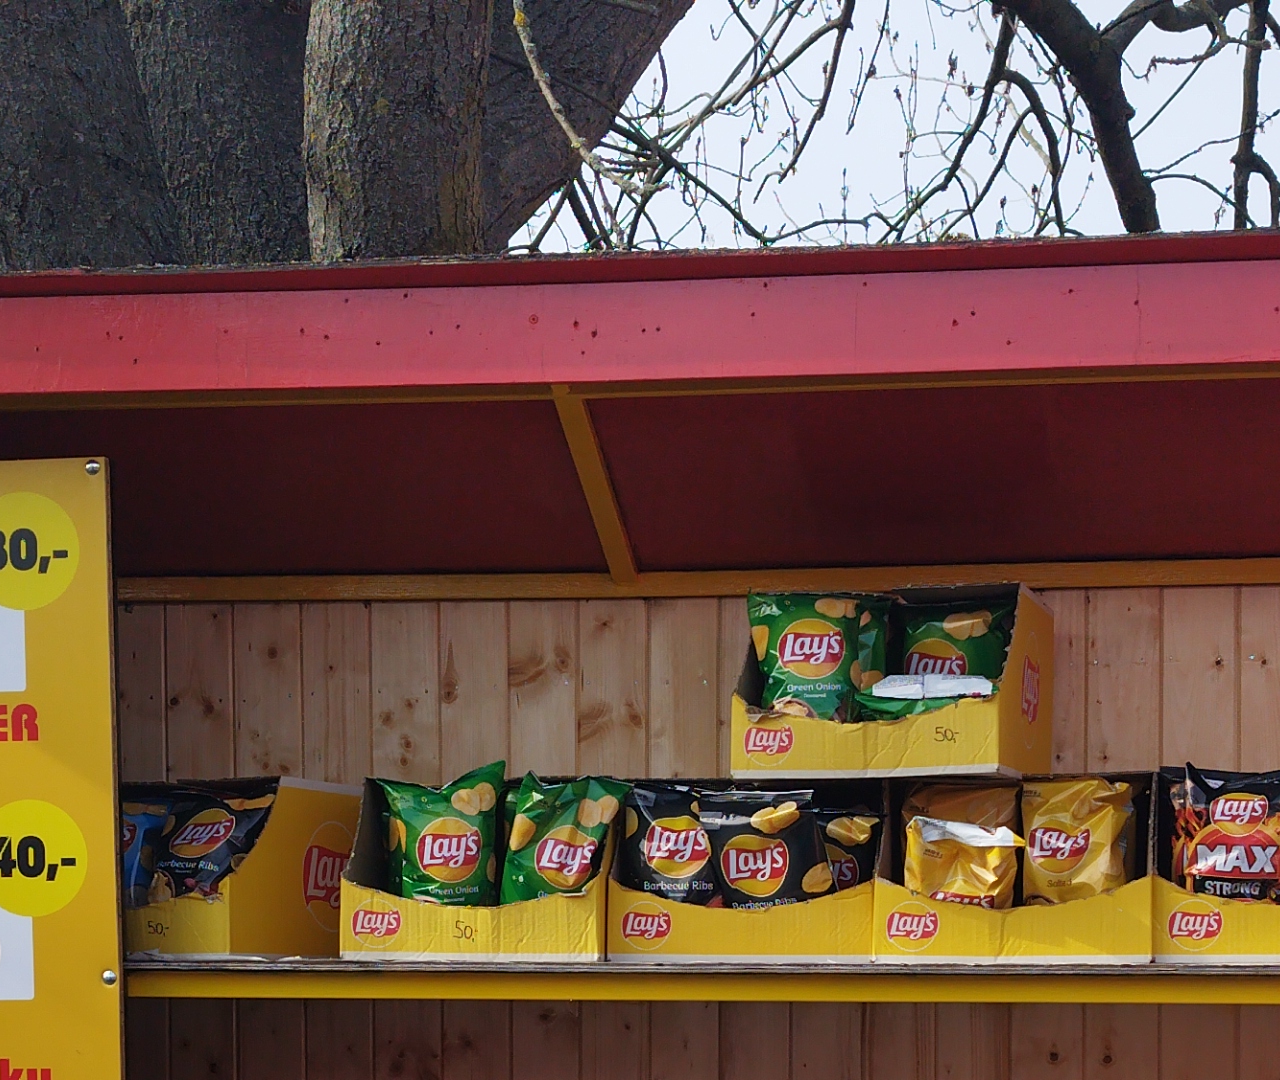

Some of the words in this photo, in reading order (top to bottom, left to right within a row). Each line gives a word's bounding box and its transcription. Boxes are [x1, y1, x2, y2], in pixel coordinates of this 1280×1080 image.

[782, 631, 842, 664] Lay's
[787, 683, 813, 692] Green
[816, 682, 841, 691] Onion
[747, 726, 791, 755] Lay's
[1214, 799, 1264, 825] Lay's
[173, 818, 233, 845] Lay's
[649, 826, 709, 863] Lay's
[1032, 829, 1088, 860] Lay's
[423, 832, 478, 868] Lay's
[539, 839, 595, 876] Lay's
[1196, 845, 1277, 873] MAX
[198, 860, 220, 871] Ribs
[728, 845, 785, 886] Lay's
[429, 887, 453, 895] Green
[456, 885, 479, 893] Onion
[644, 880, 689, 891] Barbecue
[692, 880, 713, 891] Ribs
[1204, 880, 1261, 896] STRONG
[356, 909, 400, 938] Lay's
[625, 912, 668, 937] Lay's
[890, 912, 935, 939] Lay's
[1172, 911, 1219, 939] Lay's
